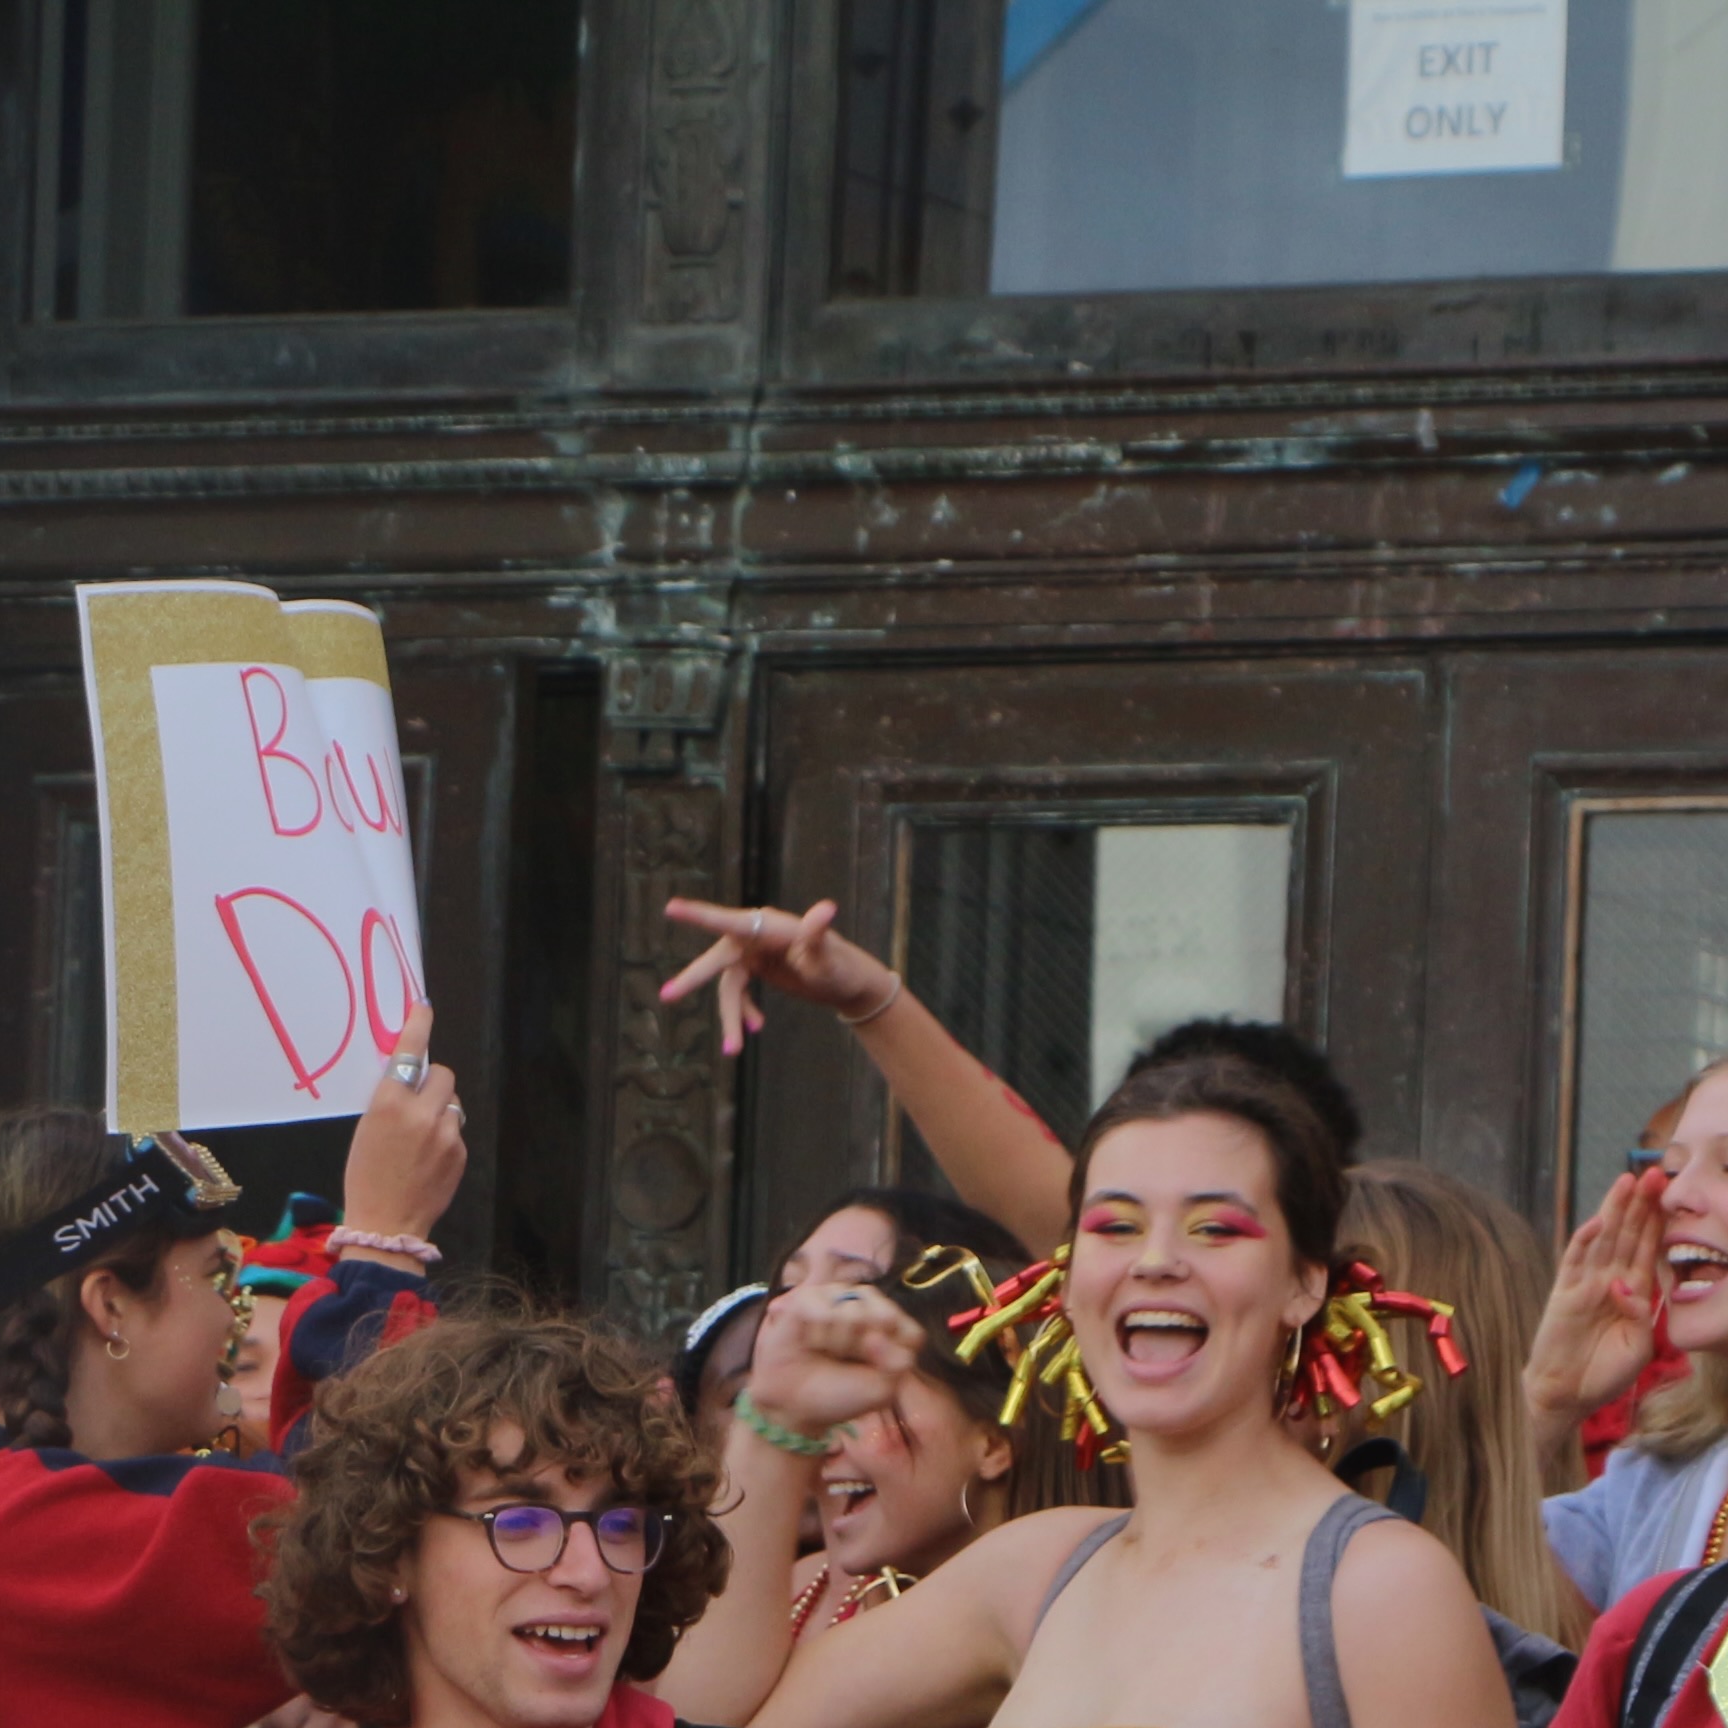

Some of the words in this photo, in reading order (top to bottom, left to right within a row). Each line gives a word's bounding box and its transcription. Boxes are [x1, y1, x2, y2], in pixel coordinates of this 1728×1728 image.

[1418, 41, 1500, 77] EXIT
[1405, 102, 1508, 139] ONLY
[53, 1173, 160, 1253] SMITH
